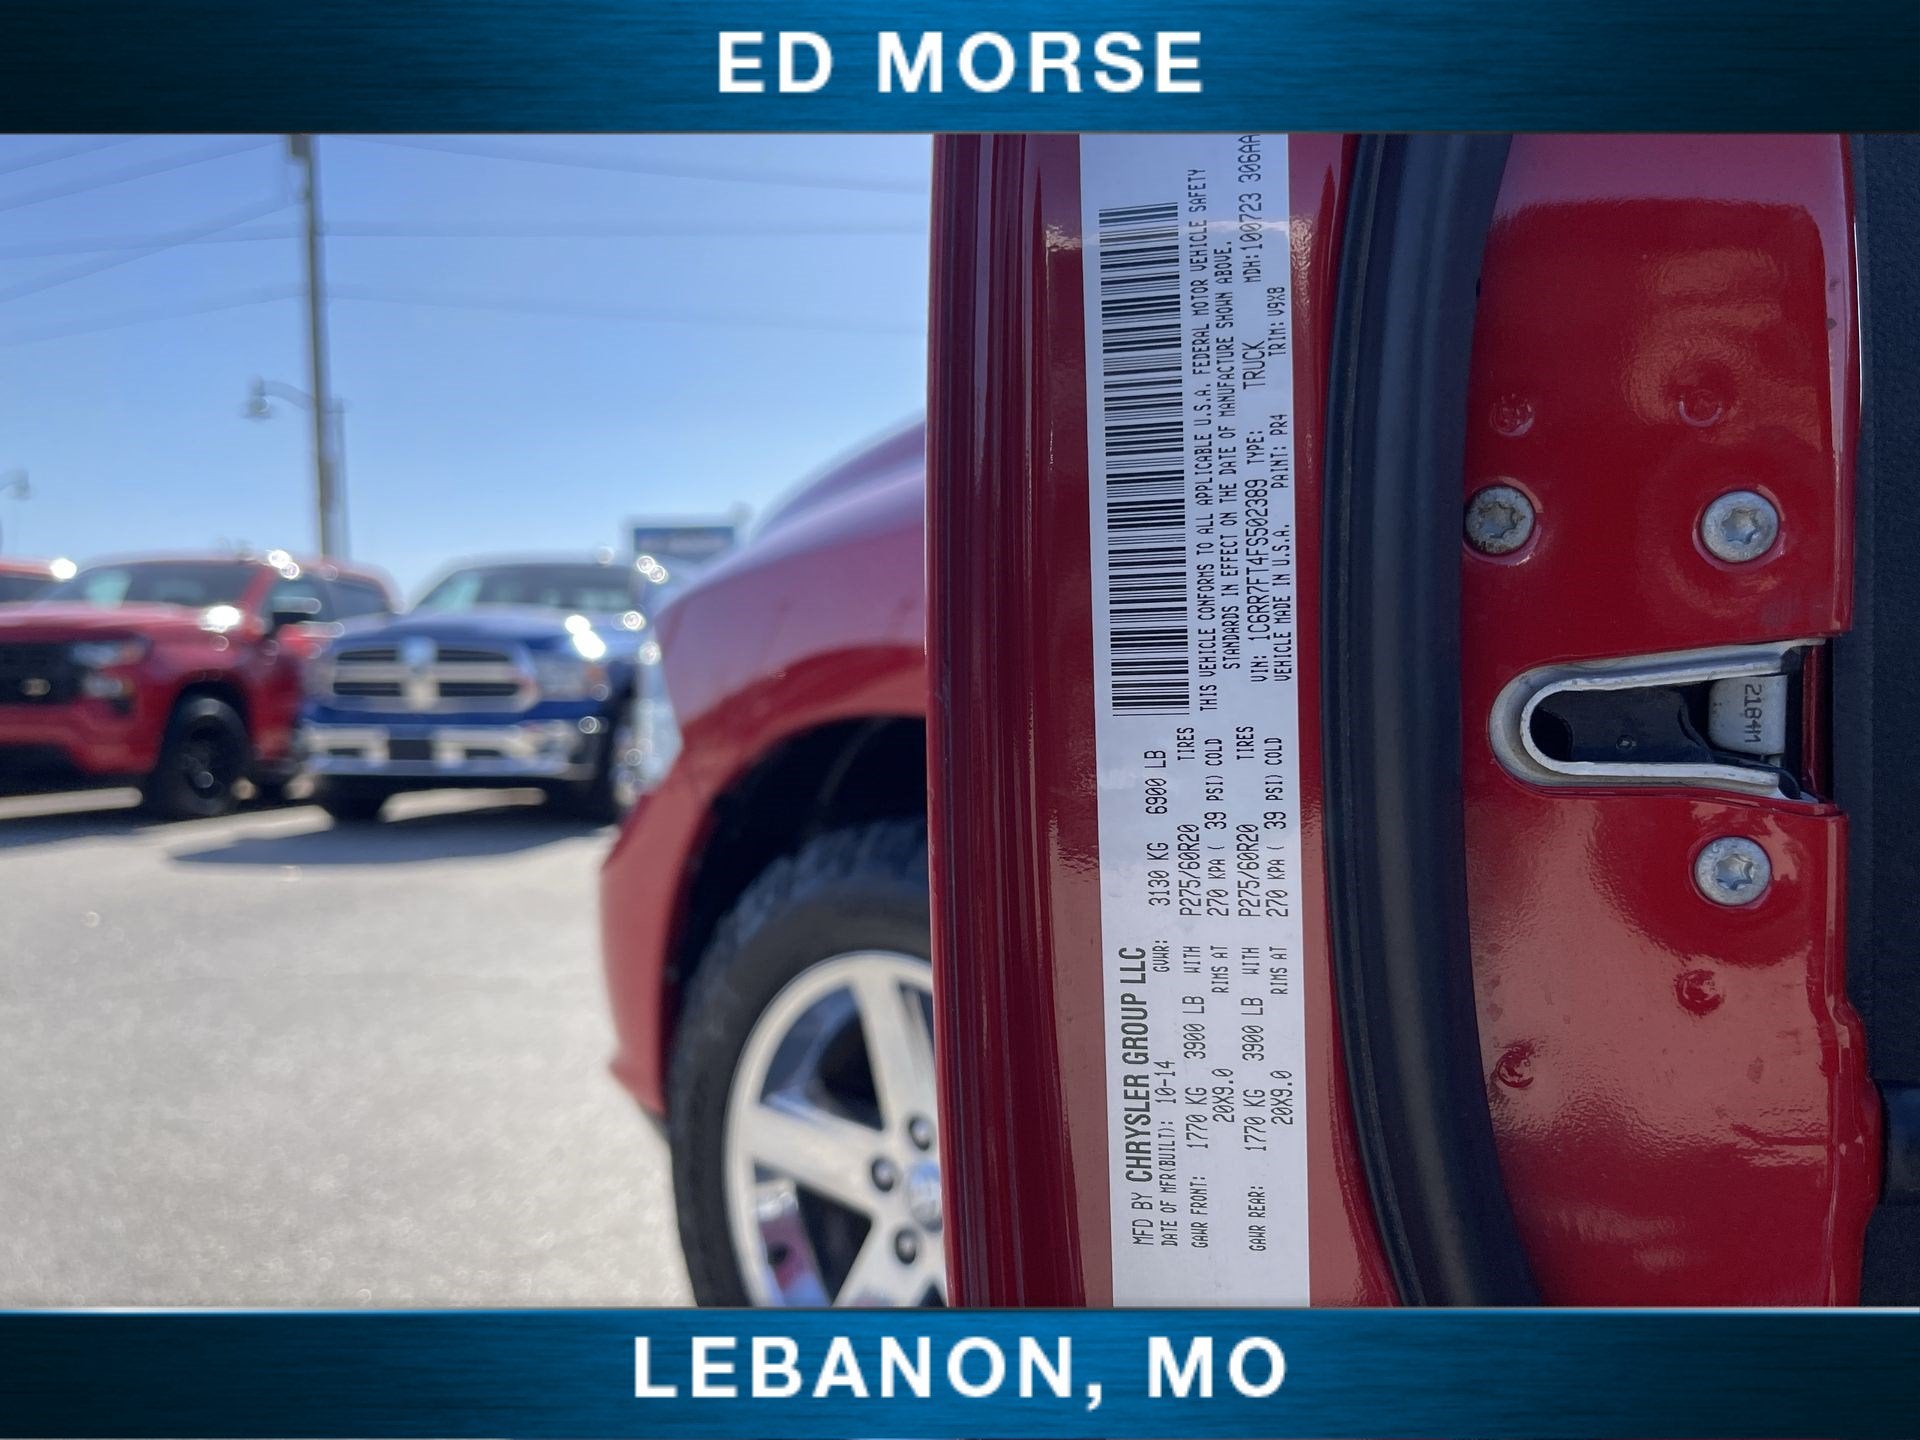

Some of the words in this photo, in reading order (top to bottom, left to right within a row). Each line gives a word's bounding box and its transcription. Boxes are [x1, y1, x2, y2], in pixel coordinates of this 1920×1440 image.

[1188, 170, 1206, 212] SAFETY
[1239, 193, 1262, 250] 100723
[1189, 220, 1208, 272] VEHICLE
[1213, 242, 1232, 284] ABOVE.
[1242, 255, 1261, 283] MDH:
[1190, 279, 1209, 316] MOTOR
[1214, 292, 1233, 329] SHOWN
[1192, 323, 1211, 375] FEDERAL
[1268, 322, 1286, 357] TRIM:
[1216, 336, 1235, 417] MANUFACTURE
[1241, 340, 1265, 390] TRUCK
[1193, 384, 1211, 426] U.S.A.
[1218, 425, 1236, 439] OF
[1269, 414, 1288, 435] PR4
[1218, 446, 1237, 475] DATE
[1246, 431, 1265, 465] TYPE:
[1193, 433, 1213, 505] APPLICABLE
[1270, 447, 1288, 489] PAINT:
[1218, 483, 1237, 504] THE
[1195, 513, 1214, 534] ALL
[1219, 512, 1238, 526] ON
[1196, 542, 1214, 556] TO
[1220, 534, 1239, 576] EFFECT
[1244, 479, 1271, 641] 1C6RR7FT4FS502389
[1272, 525, 1290, 566] U.S.A.
[1195, 564, 1217, 620] CONFORMS
[1220, 584, 1241, 597] IN
[1272, 574, 1290, 586] IN
[1272, 595, 1291, 624] MADE
[1198, 628, 1217, 677] VEHICLE
[1220, 606, 1240, 669] STANDARDS
[1250, 656, 1269, 682] VIN:
[1273, 632, 1292, 681] VEHICLE
[1199, 685, 1218, 711] THIS
[1177, 728, 1195, 760] TIRES
[1204, 739, 1223, 766] COLD
[1236, 727, 1255, 760] TIRES
[1264, 738, 1282, 765] COLD
[1144, 751, 1166, 768] LB
[1145, 778, 1167, 814] 6900
[1205, 775, 1224, 801] PSI)
[1265, 775, 1283, 800] PSI)
[1204, 812, 1227, 830] 39
[1263, 812, 1286, 829] 39
[1146, 843, 1169, 860] KG
[1177, 824, 1202, 916] P275/60R20
[1208, 859, 1226, 879] KPA
[1236, 824, 1261, 916] P275/60R20
[1267, 859, 1285, 879] KPA
[1148, 870, 1170, 906] 3130
[1206, 889, 1229, 916] 270
[1265, 890, 1288, 917] 270
[1118, 948, 1146, 984] LLC
[1152, 941, 1170, 972] GVWR:
[1183, 946, 1201, 973] WITH
[1210, 946, 1228, 958] AT
[1241, 948, 1260, 975] WITH
[1269, 946, 1287, 960] AT
[1211, 966, 1229, 993] RIMS
[1269, 968, 1288, 994] RIMS
[1182, 996, 1204, 1014] LB
[1241, 998, 1263, 1015] LB
[1121, 993, 1149, 1065] GROUP
[1183, 1024, 1206, 1059] 3900
[1241, 1025, 1264, 1061] 3900
[1153, 1061, 1176, 1104] 10-14
[1185, 1087, 1208, 1105] KG
[1211, 1069, 1235, 1122] 20X9.0
[1243, 1089, 1266, 1107] KG
[1270, 1071, 1293, 1125] 20X9.0
[1123, 1074, 1153, 1182] CHRYSLER
[1185, 1114, 1208, 1148] 1770
[1244, 1117, 1266, 1151] 1770
[1158, 1121, 1176, 1193] MFR(BUILT):
[1131, 1192, 1153, 1210] BY
[1160, 1200, 1177, 1213] OF
[1189, 1177, 1208, 1215] FRONT:
[1248, 1186, 1266, 1218] REAR:
[1132, 1219, 1154, 1245] MFD
[1160, 1220, 1178, 1246] DATE
[1190, 1222, 1208, 1248] GAWR
[1248, 1225, 1266, 1251] GAWR
